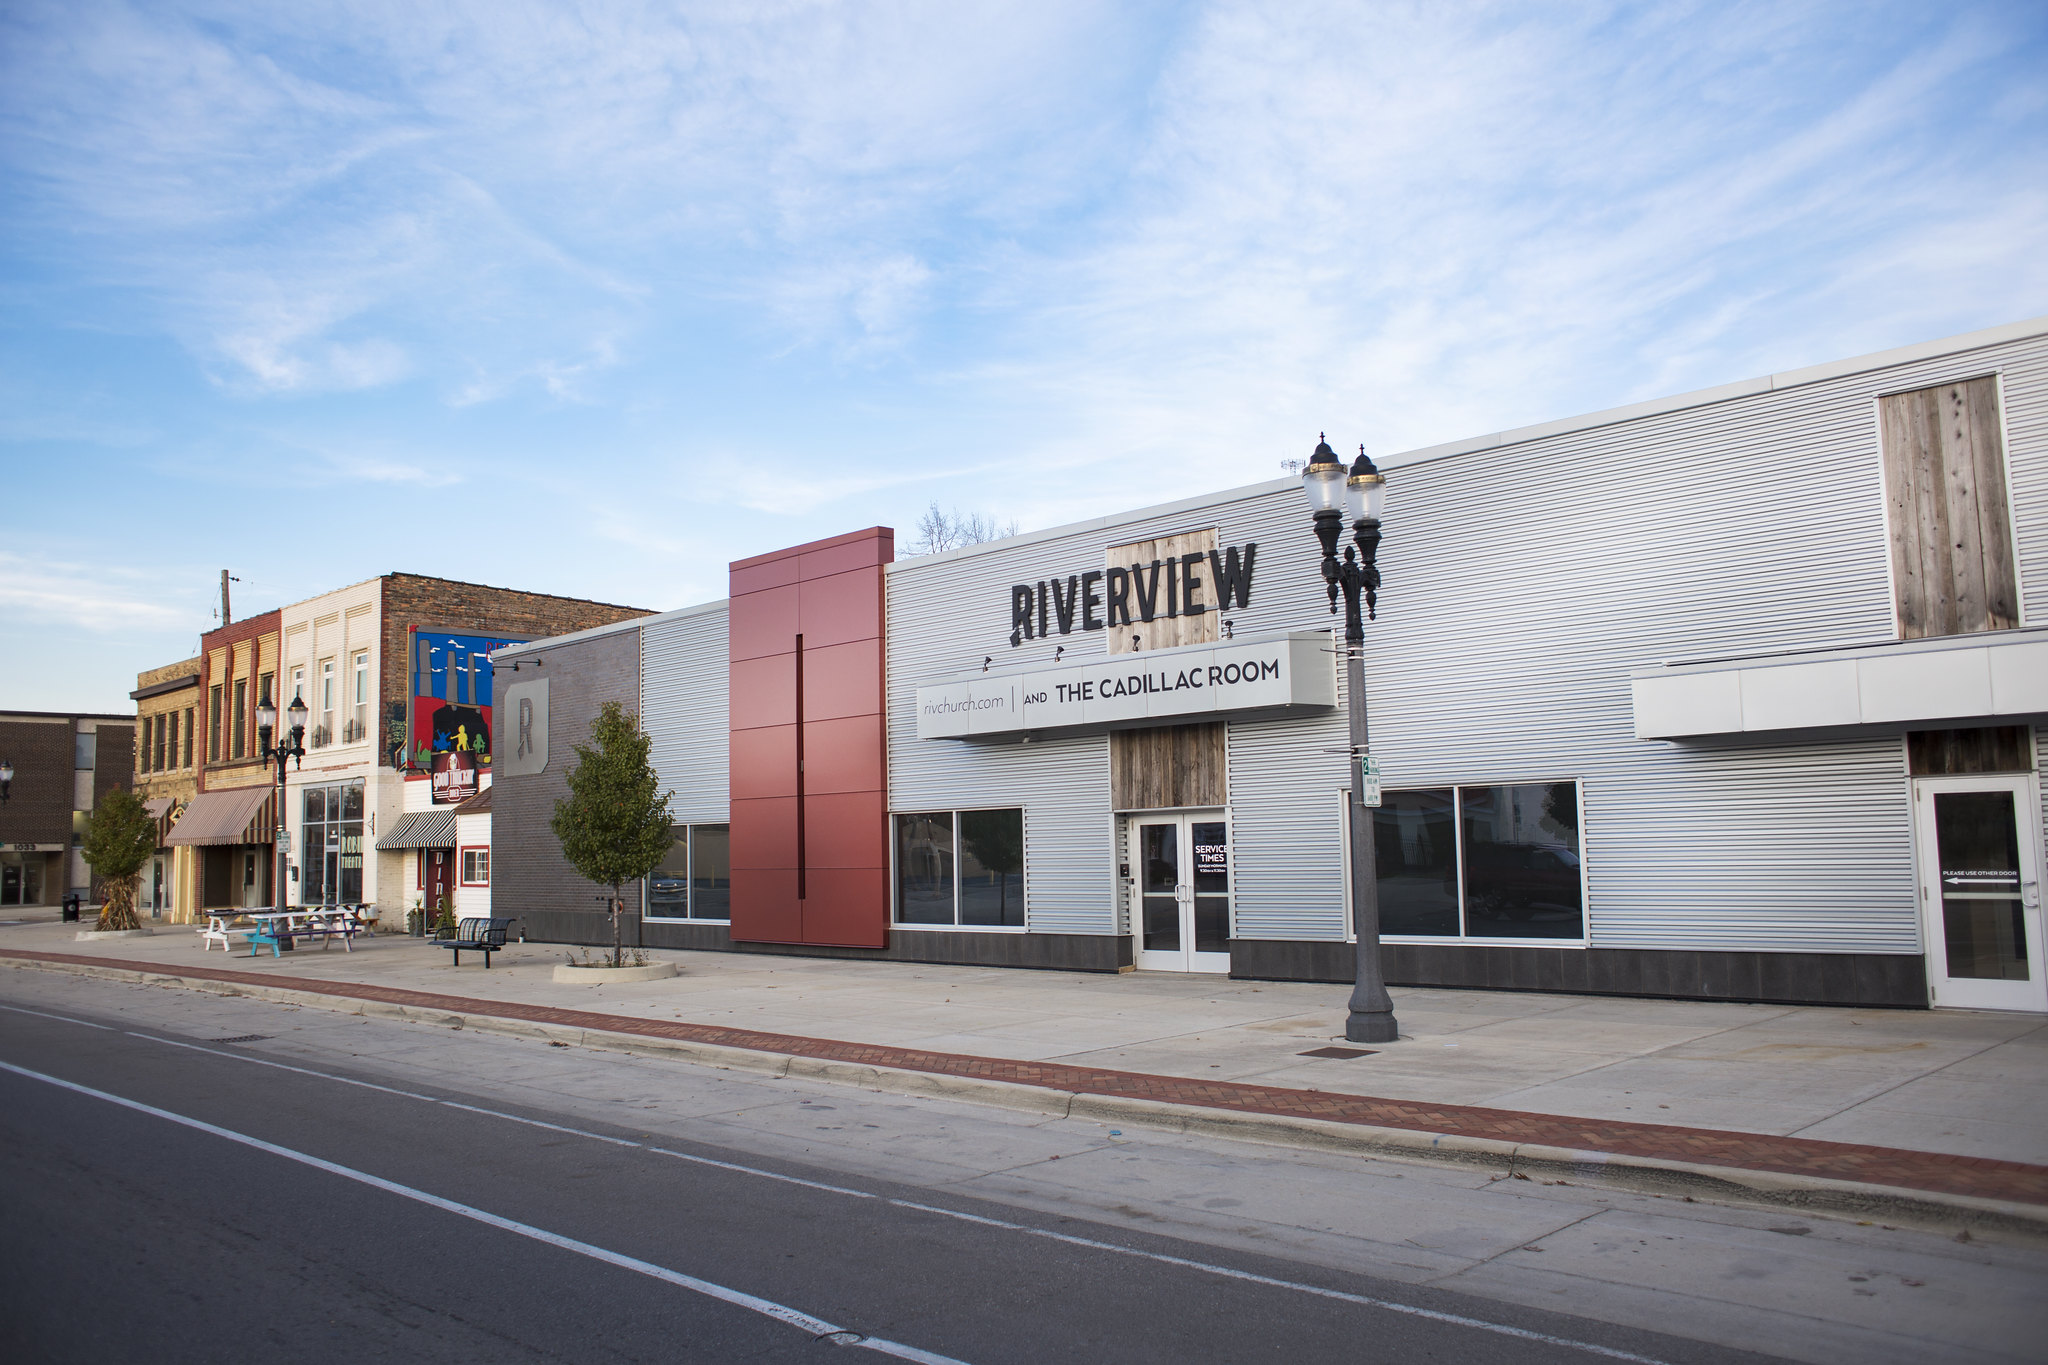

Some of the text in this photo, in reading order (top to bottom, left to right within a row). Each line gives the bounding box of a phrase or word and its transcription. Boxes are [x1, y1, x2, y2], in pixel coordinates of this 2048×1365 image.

[1009, 543, 1257, 648] RIVERVIEW
[924, 658, 1280, 715] rivchurch.com AND THE CADILLAC ROOM
[518, 697, 533, 761] R
[1200, 854, 1224, 862] TIMES
